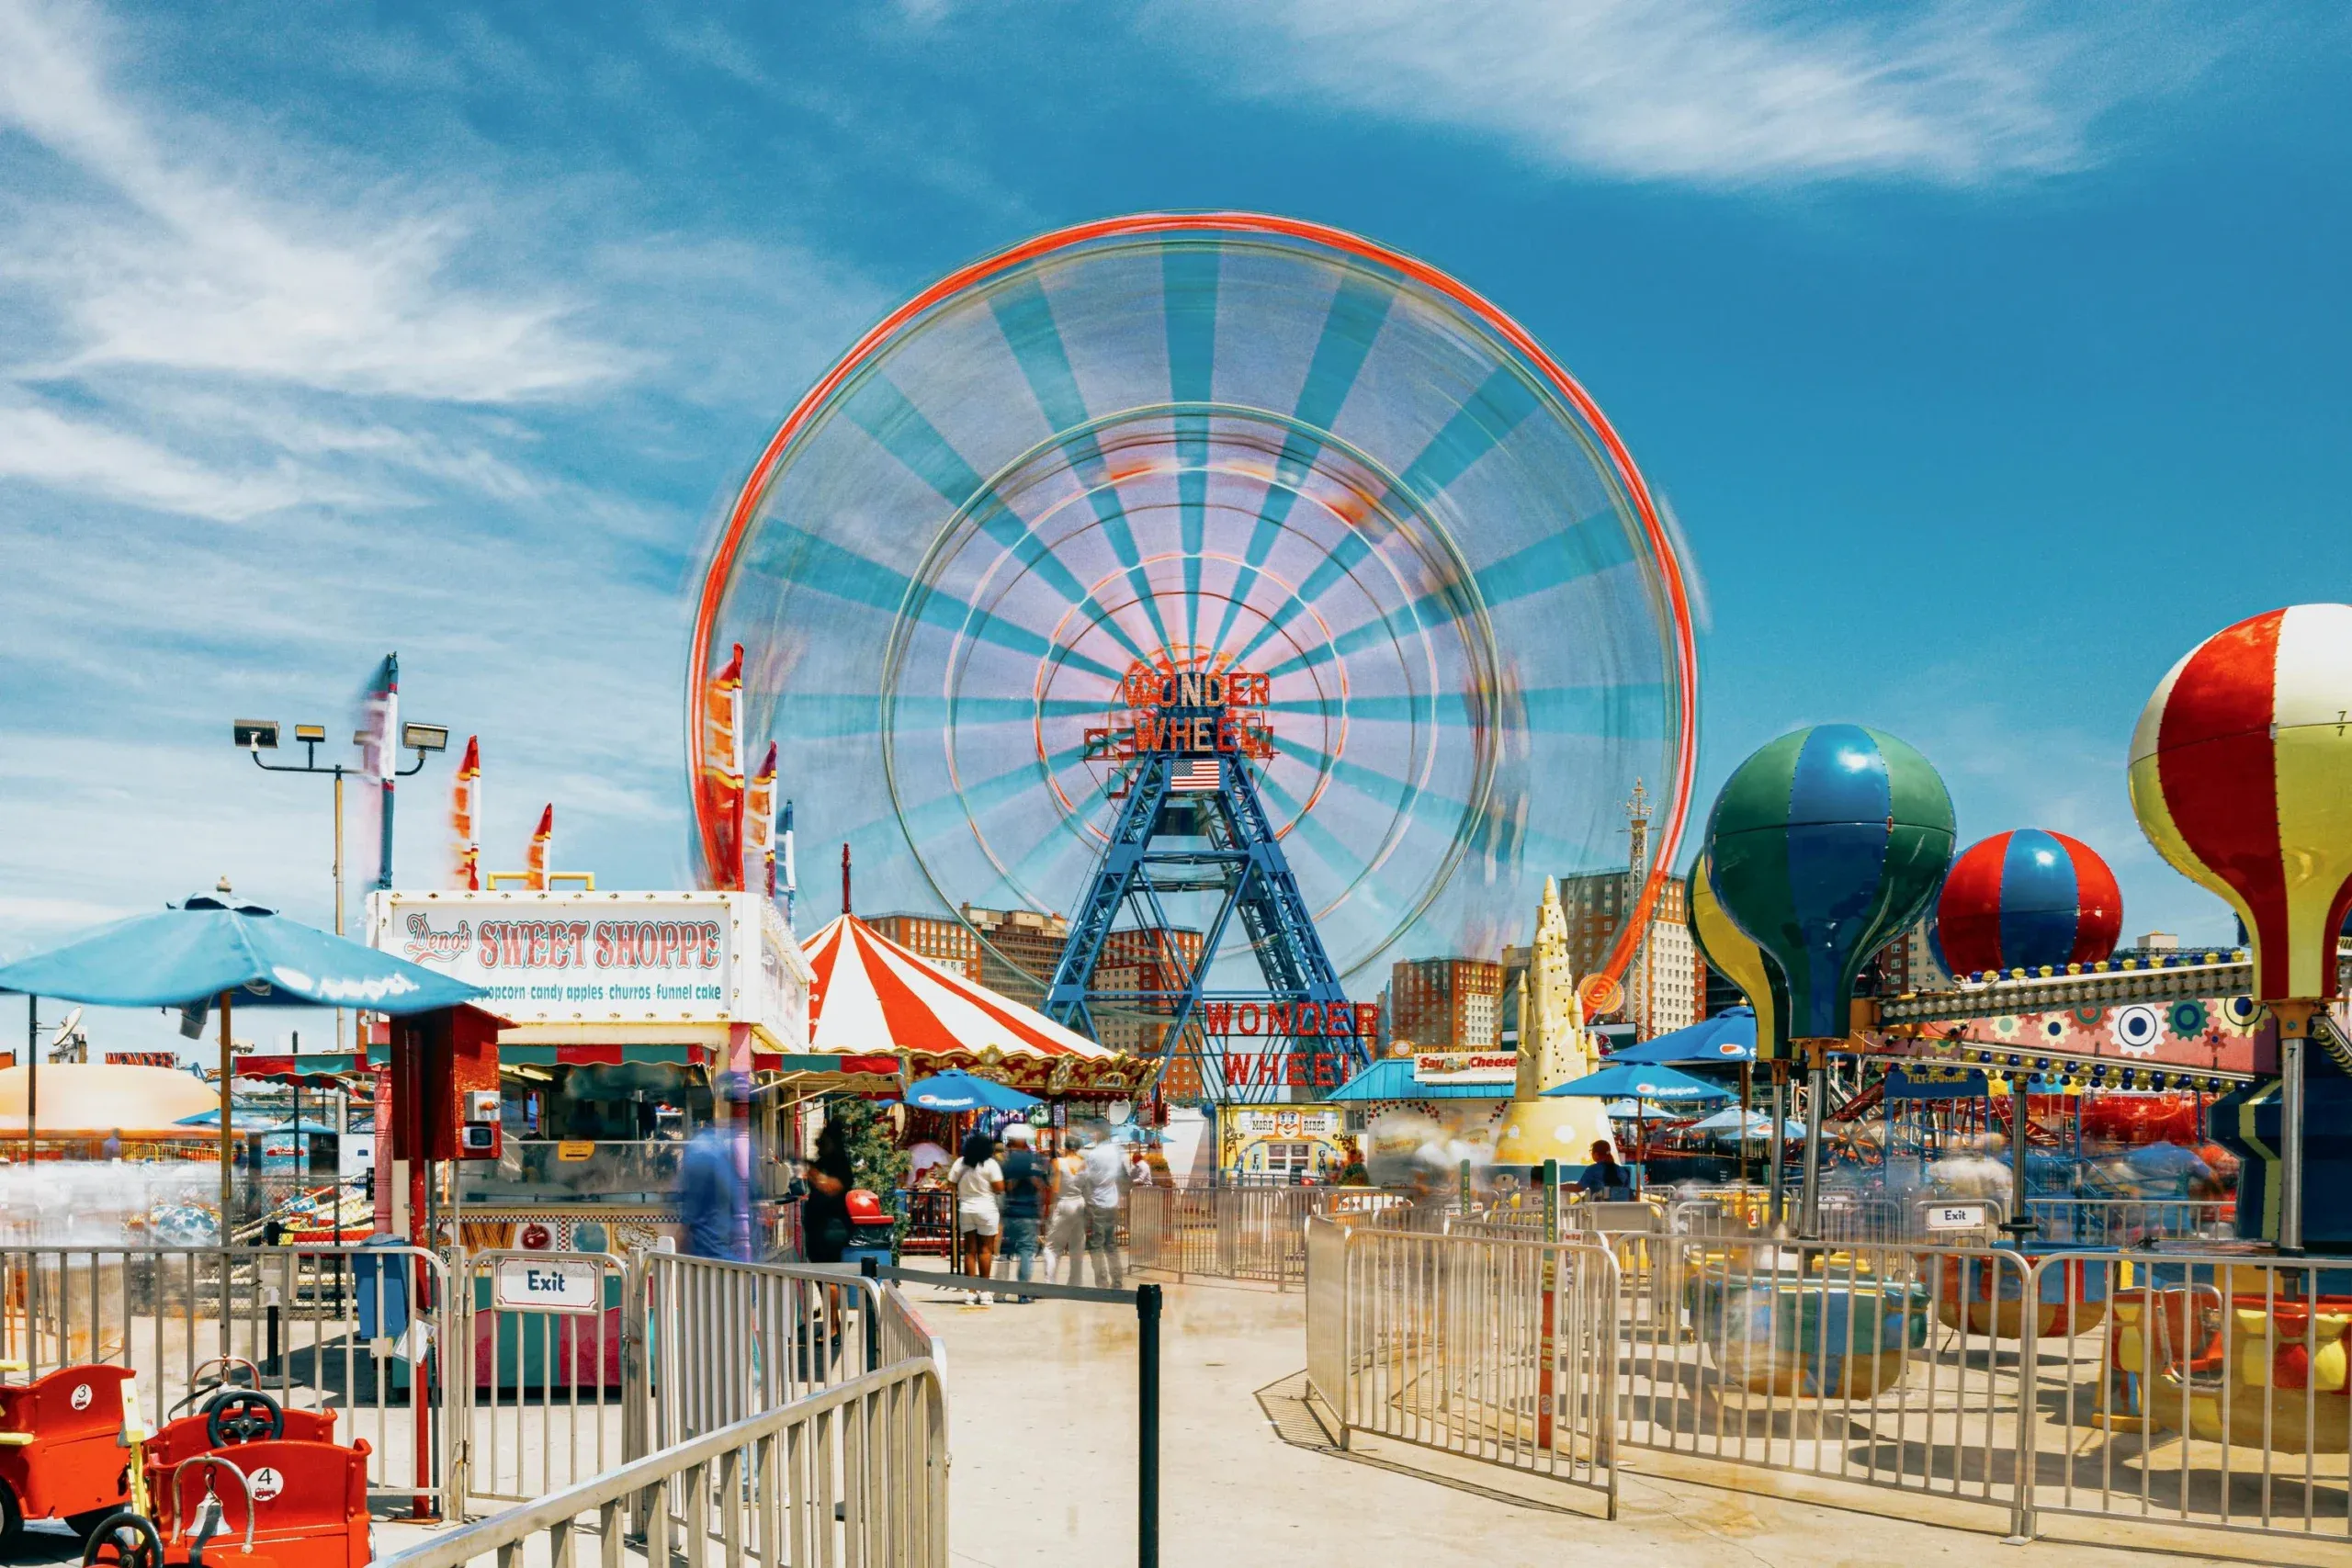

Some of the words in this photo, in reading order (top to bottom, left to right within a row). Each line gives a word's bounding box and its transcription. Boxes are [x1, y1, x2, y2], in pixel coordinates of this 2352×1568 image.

[1124, 672, 1270, 707] WONDER
[2337, 710, 2346, 721] 7
[1134, 716, 1260, 752] WHEEL
[2336, 726, 2346, 737] 7
[405, 913, 472, 960] Deno's
[478, 919, 591, 969] SWEET
[594, 919, 721, 970] SHOPPE
[531, 984, 563, 1002] candy
[566, 984, 604, 1002] apples
[609, 984, 651, 999] churros
[656, 984, 693, 1000] funnel
[695, 984, 721, 999] cake
[1204, 1002, 1380, 1037] WONDER
[2288, 1047, 2297, 1058] 7
[1419, 1056, 1445, 1070] Say
[1469, 1055, 1518, 1068] Cheese
[1251, 1120, 1274, 1131] MORE
[1303, 1120, 1326, 1132] RIDES
[1944, 1210, 1967, 1221] Exit
[527, 1269, 566, 1292] Exit
[77, 1384, 87, 1399] 3
[257, 1468, 273, 1485] 4
